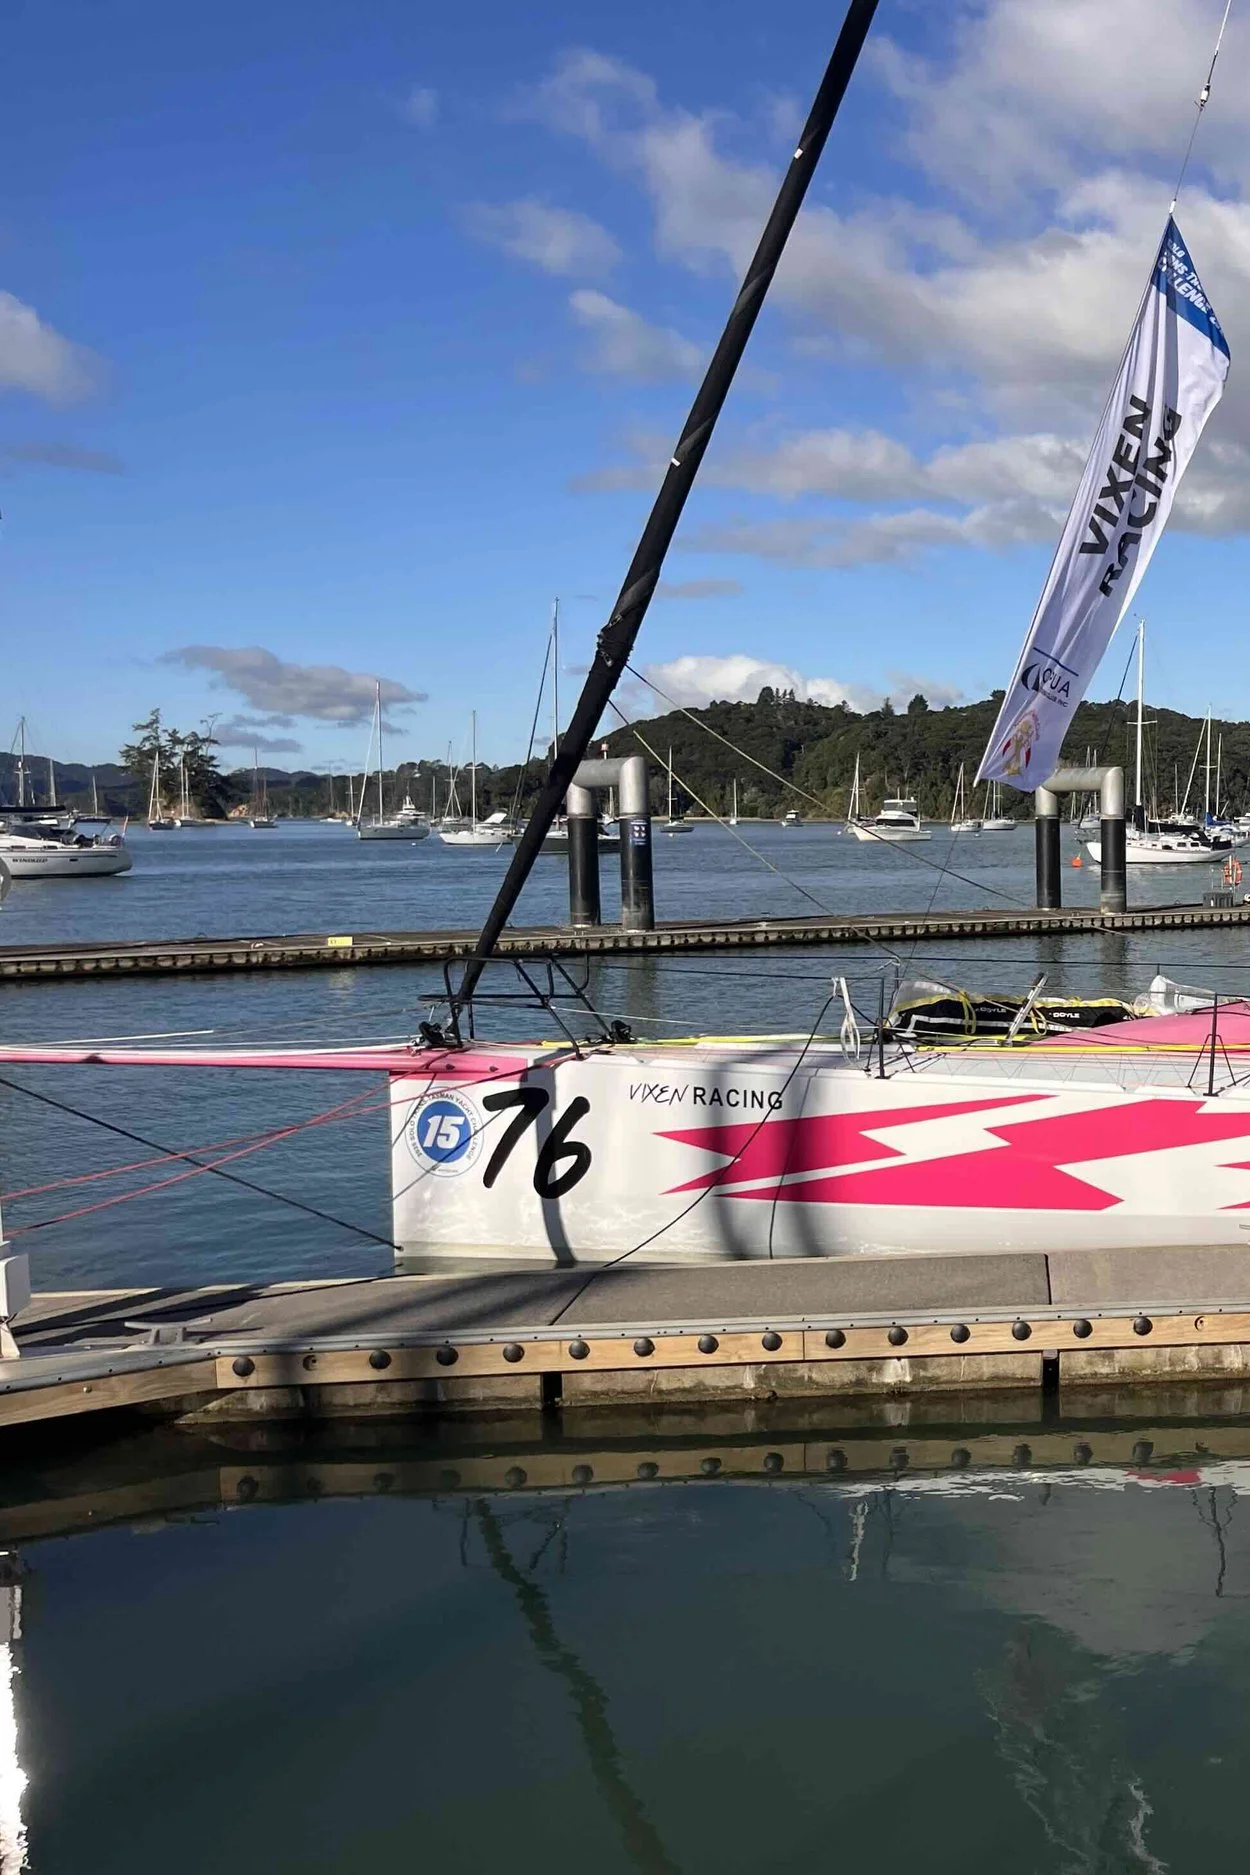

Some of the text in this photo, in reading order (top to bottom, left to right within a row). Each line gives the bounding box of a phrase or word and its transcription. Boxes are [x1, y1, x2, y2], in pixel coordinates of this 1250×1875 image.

[1079, 395, 1151, 555] VIXEN
[1099, 406, 1182, 597] RACING
[1042, 668, 1070, 698] OUA
[422, 1115, 466, 1149] 15
[627, 1083, 783, 1110] VIXEN RACING
[482, 1087, 592, 1200] 76
